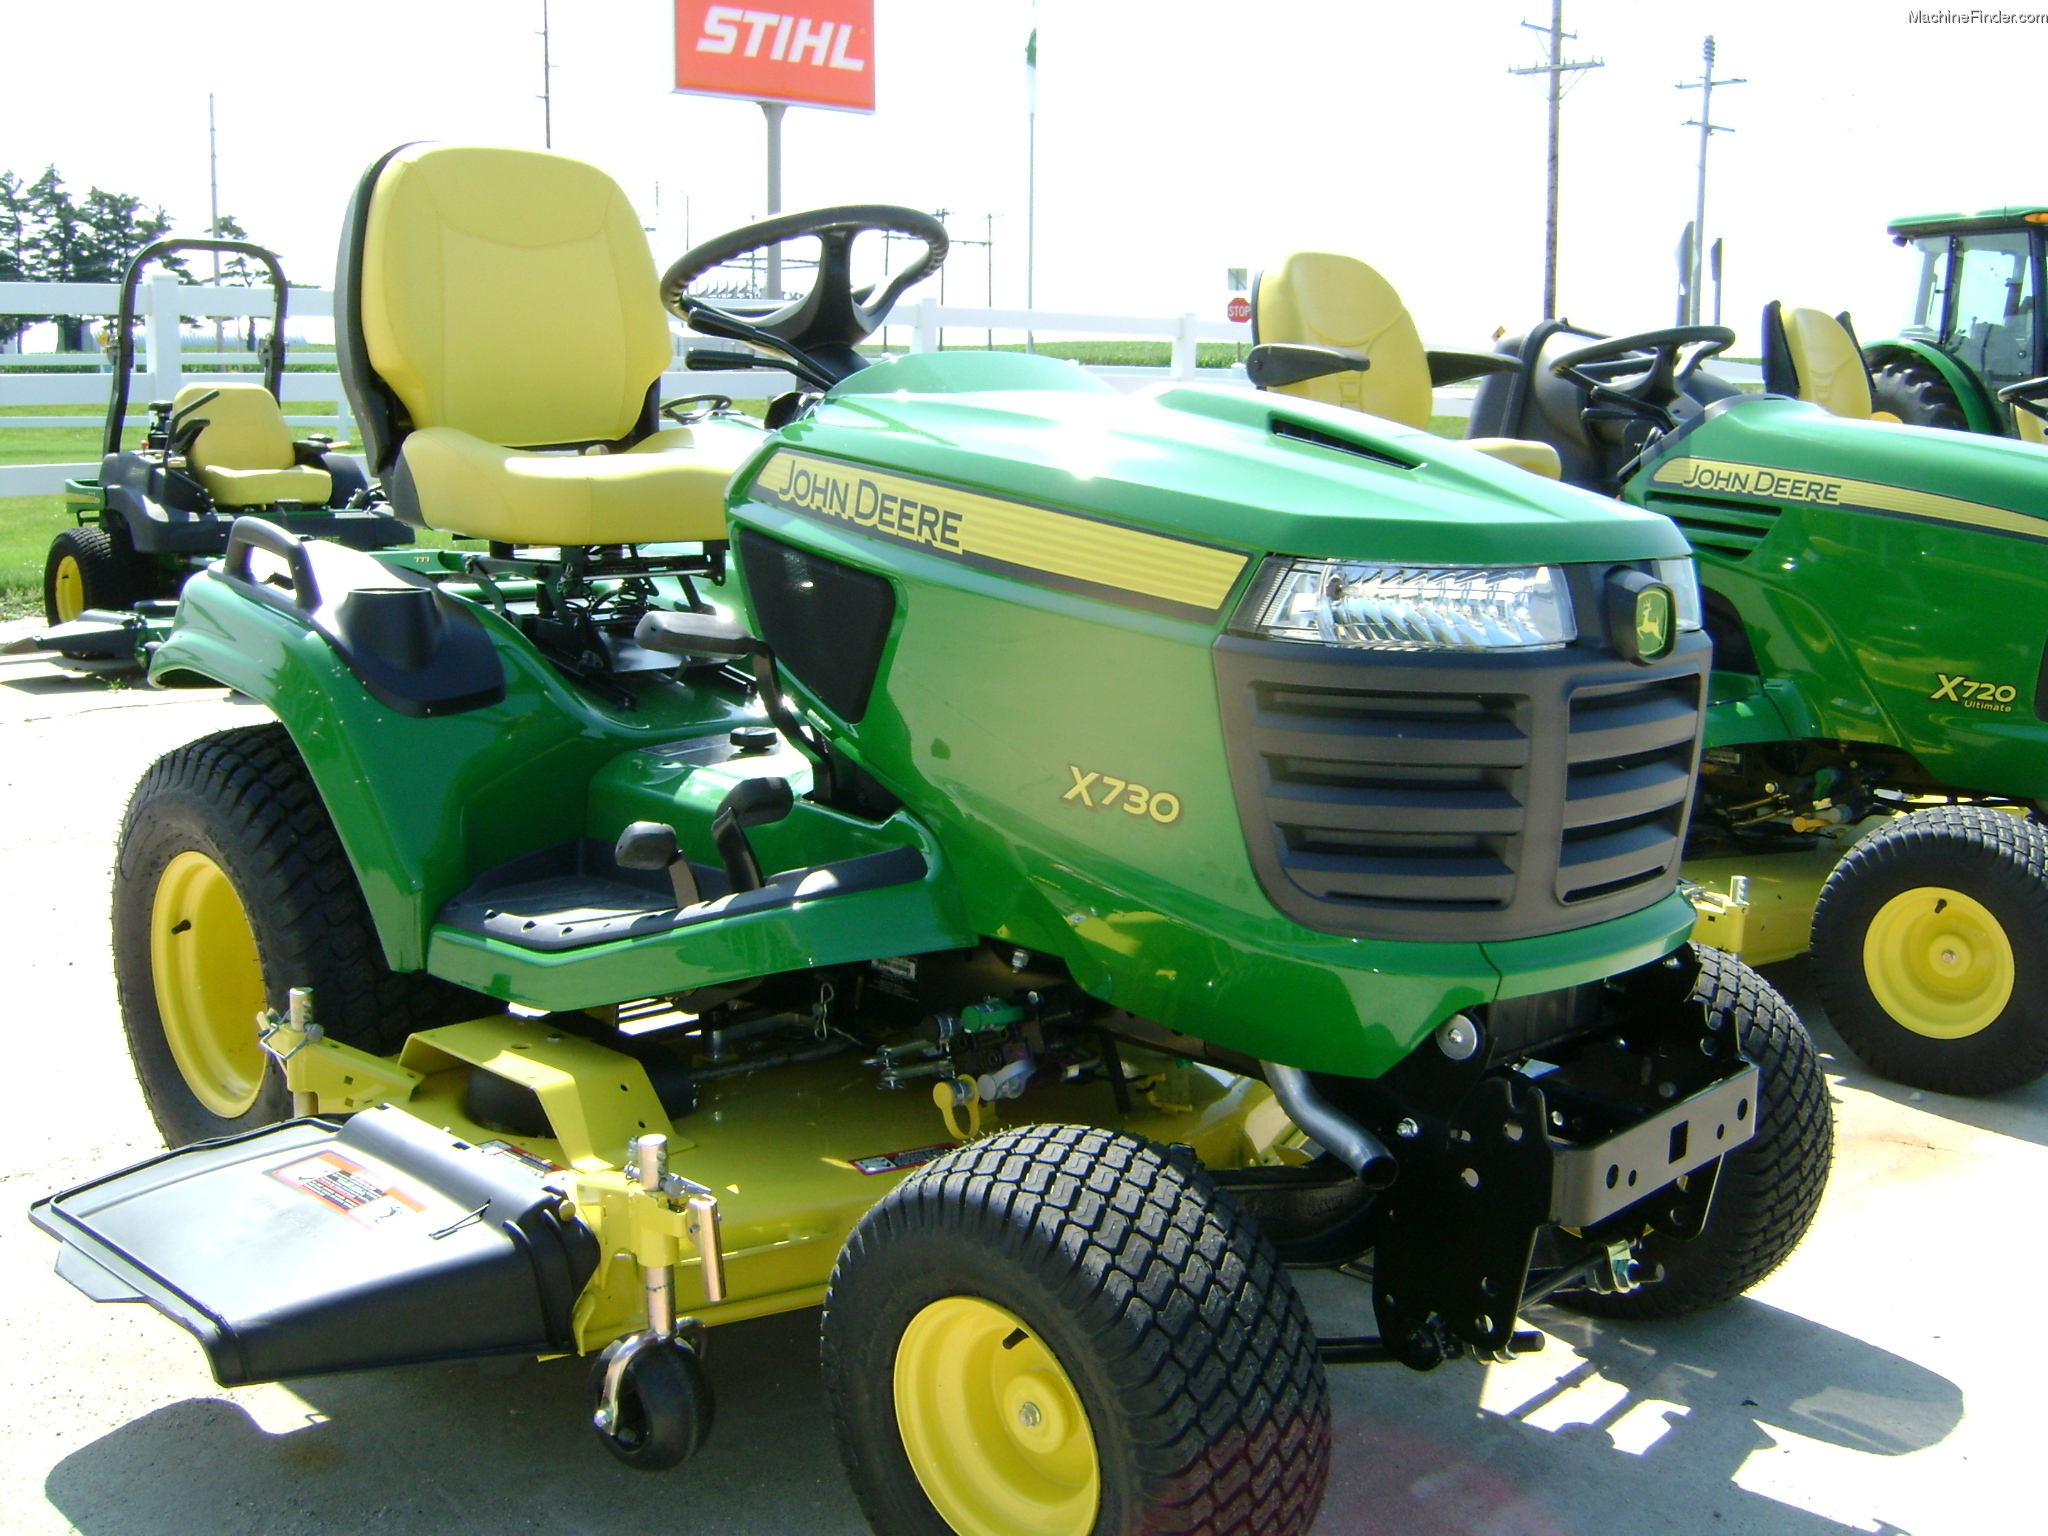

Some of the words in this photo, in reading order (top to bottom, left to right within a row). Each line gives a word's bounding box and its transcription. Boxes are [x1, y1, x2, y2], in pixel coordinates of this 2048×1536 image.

[696, 5, 865, 72] STIHL
[1228, 305, 1251, 317] STOP
[1683, 464, 1750, 491] JOHN
[1753, 471, 1842, 502] DEERE
[778, 460, 850, 515] JOHN
[854, 478, 964, 549] DEERE
[1930, 673, 2017, 703] X720
[1964, 700, 2012, 713] Ultimate
[1062, 764, 1180, 823] X730
